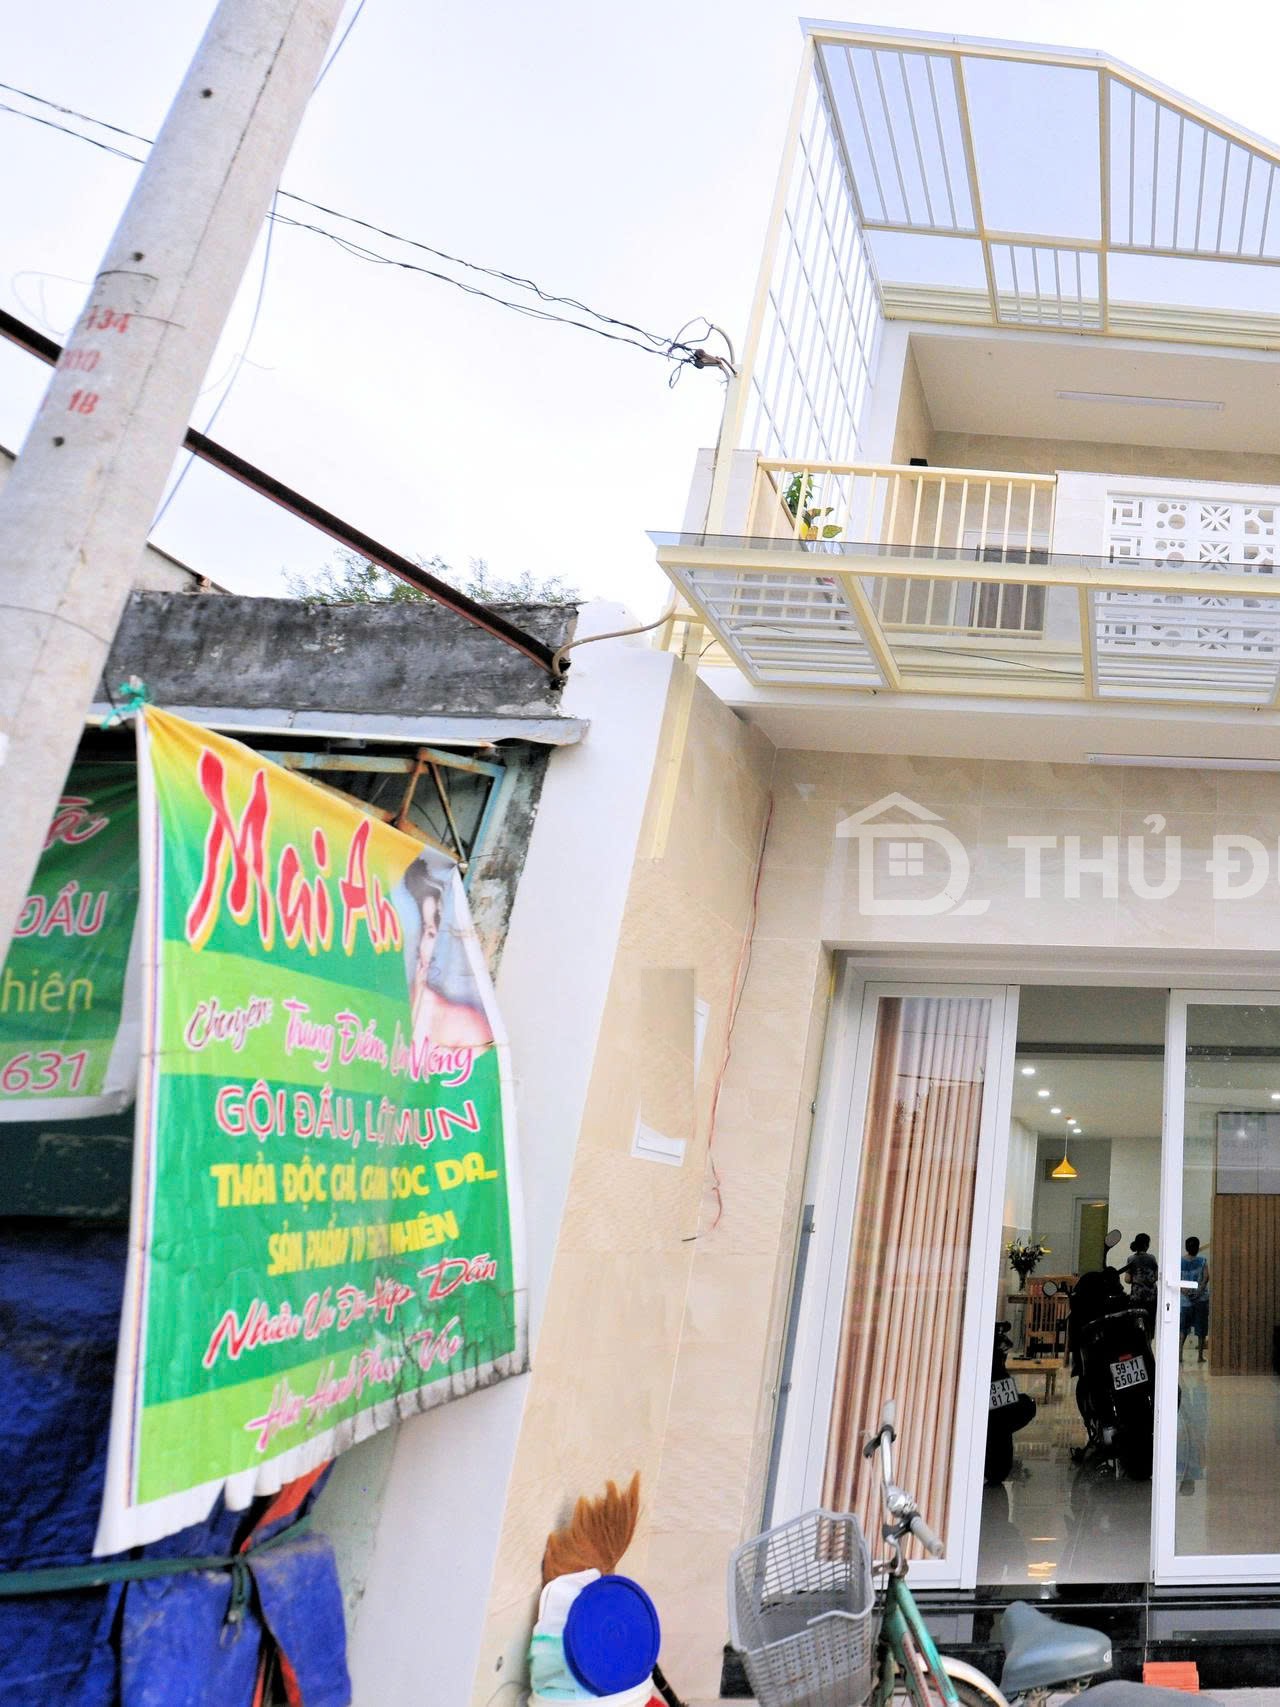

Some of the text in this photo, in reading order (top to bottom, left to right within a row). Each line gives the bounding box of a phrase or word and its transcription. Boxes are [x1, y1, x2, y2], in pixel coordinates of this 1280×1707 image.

[67, 389, 100, 415] 18
[185, 746, 330, 956] Mai
[215, 1080, 286, 1142] GỘI
